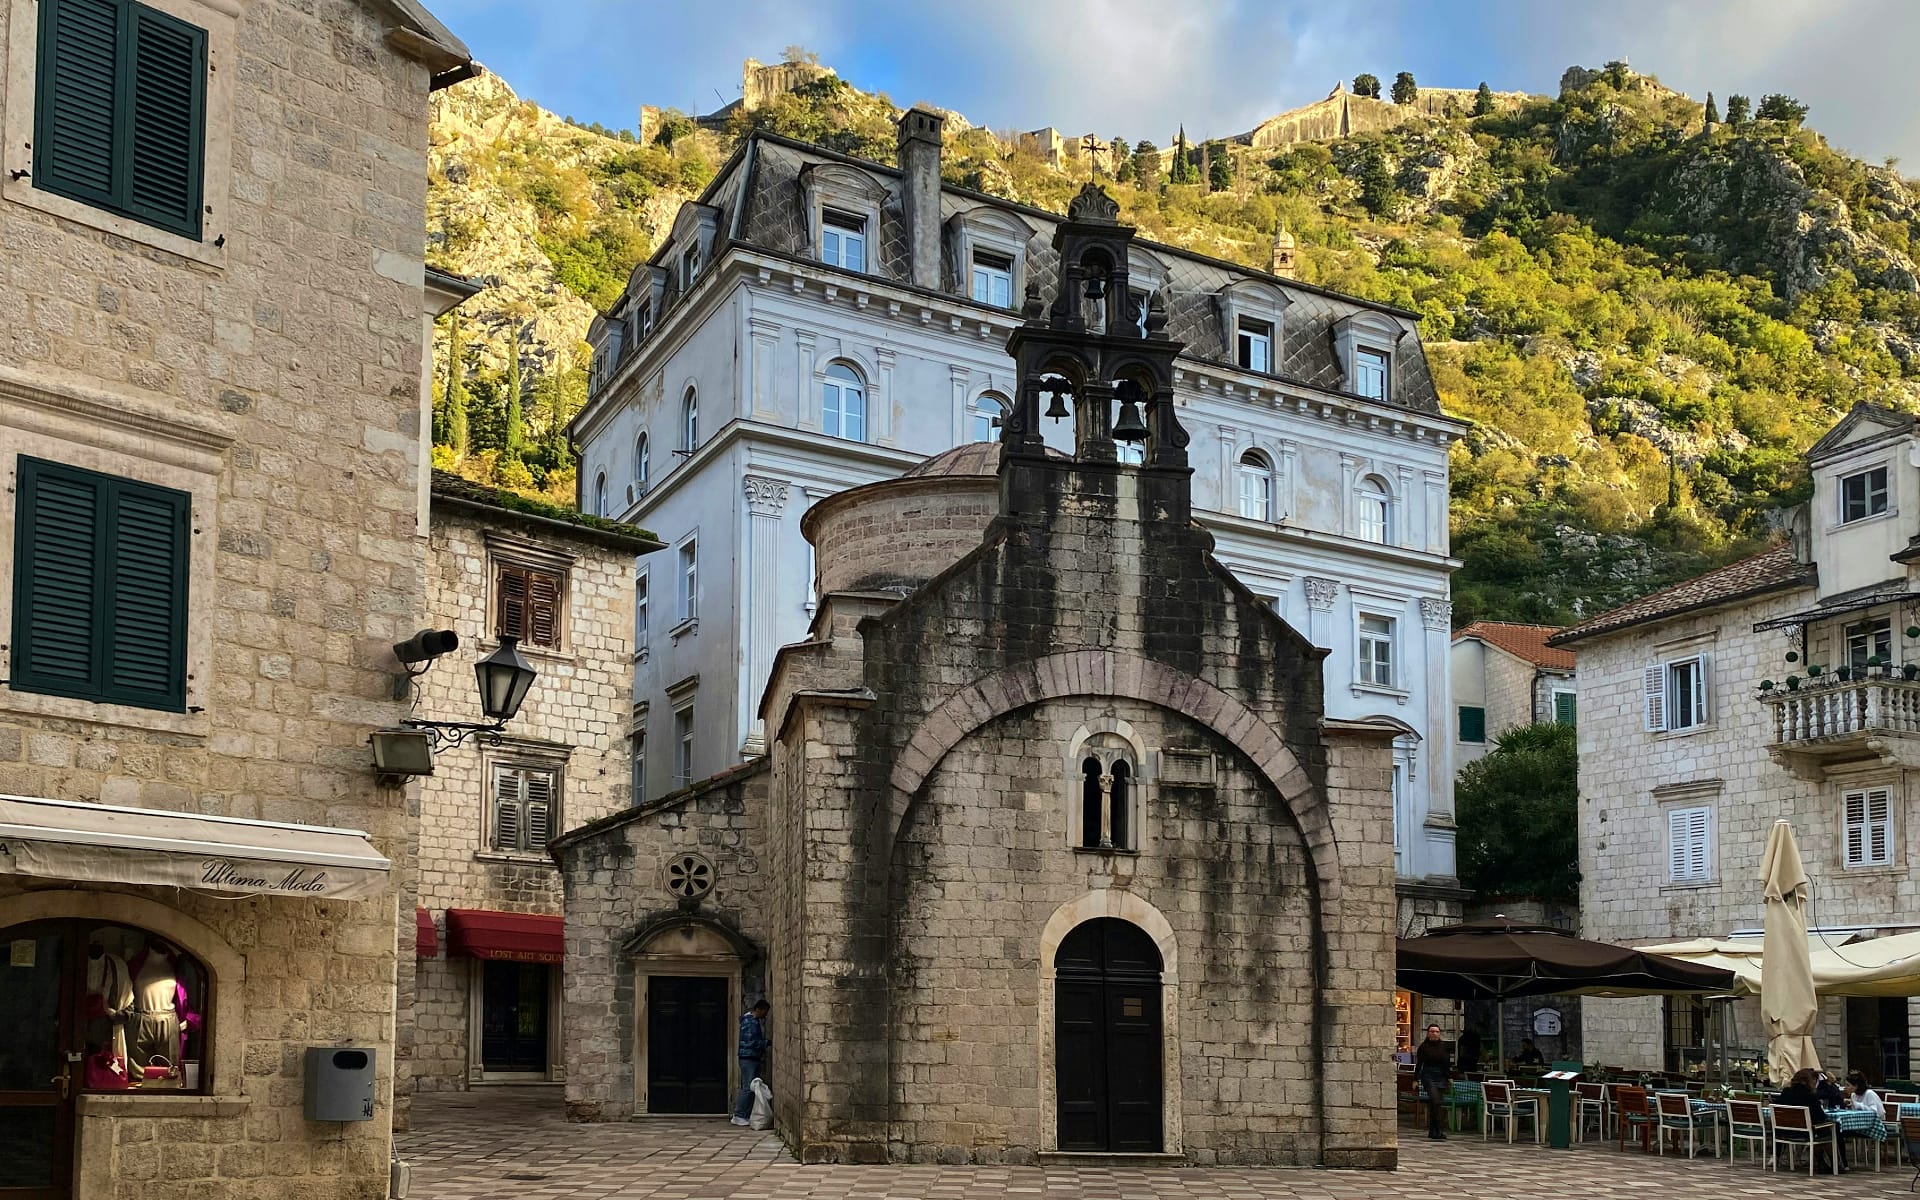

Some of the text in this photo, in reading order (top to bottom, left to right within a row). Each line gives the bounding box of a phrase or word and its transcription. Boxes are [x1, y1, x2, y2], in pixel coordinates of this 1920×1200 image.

[201, 858, 326, 892] Ultima Moda
[490, 949, 512, 959] LOST
[517, 951, 535, 960] ART
